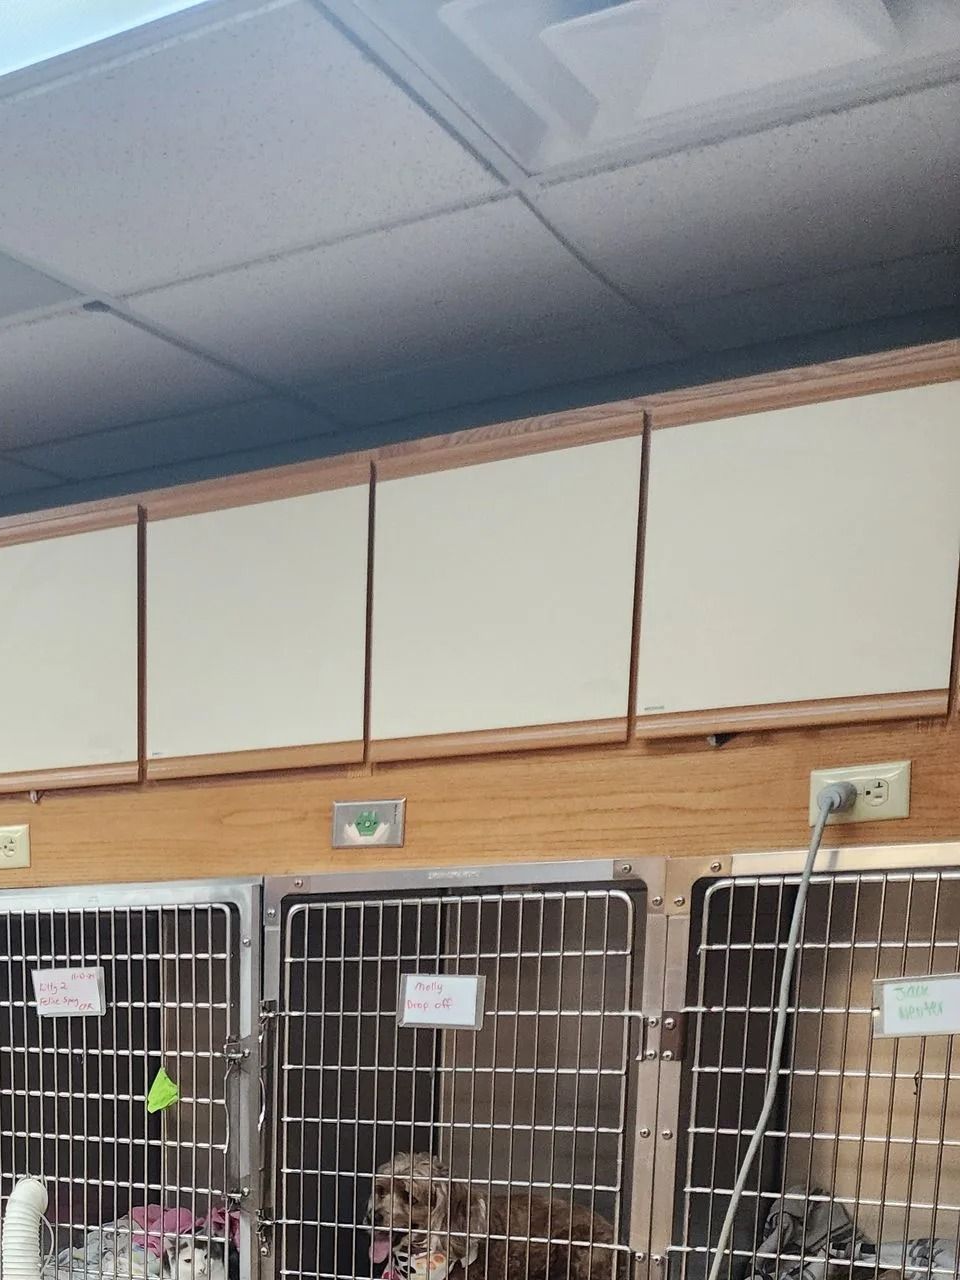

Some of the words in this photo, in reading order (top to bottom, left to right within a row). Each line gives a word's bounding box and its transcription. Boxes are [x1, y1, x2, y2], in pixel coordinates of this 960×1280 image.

[60, 982, 67, 990] 2
[415, 981, 443, 994] Molly
[406, 999, 429, 1011] Drop
[434, 997, 453, 1009] off
